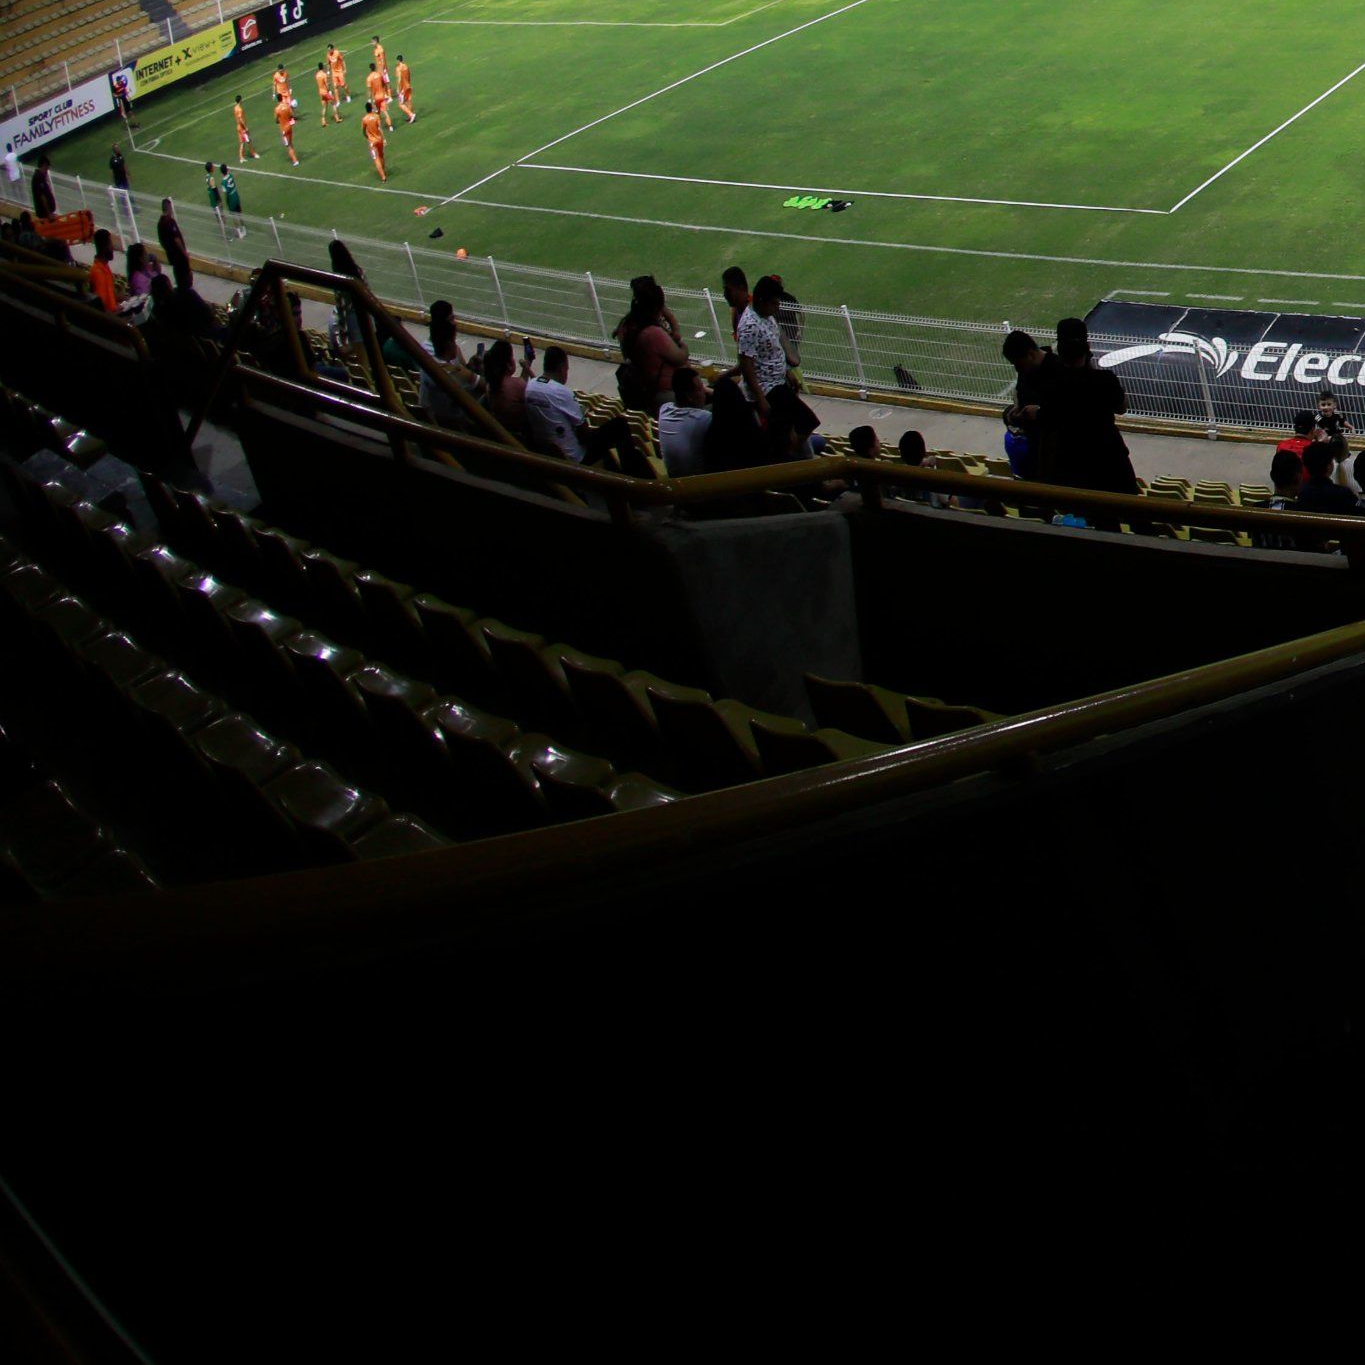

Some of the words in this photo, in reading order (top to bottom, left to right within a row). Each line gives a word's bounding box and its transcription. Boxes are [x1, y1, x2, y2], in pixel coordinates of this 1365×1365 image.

[135, 55, 173, 82] INTERNET
[13, 99, 96, 149] FAMILYFITNESS
[28, 109, 53, 127] SPORT
[54, 99, 73, 115] CLUB
